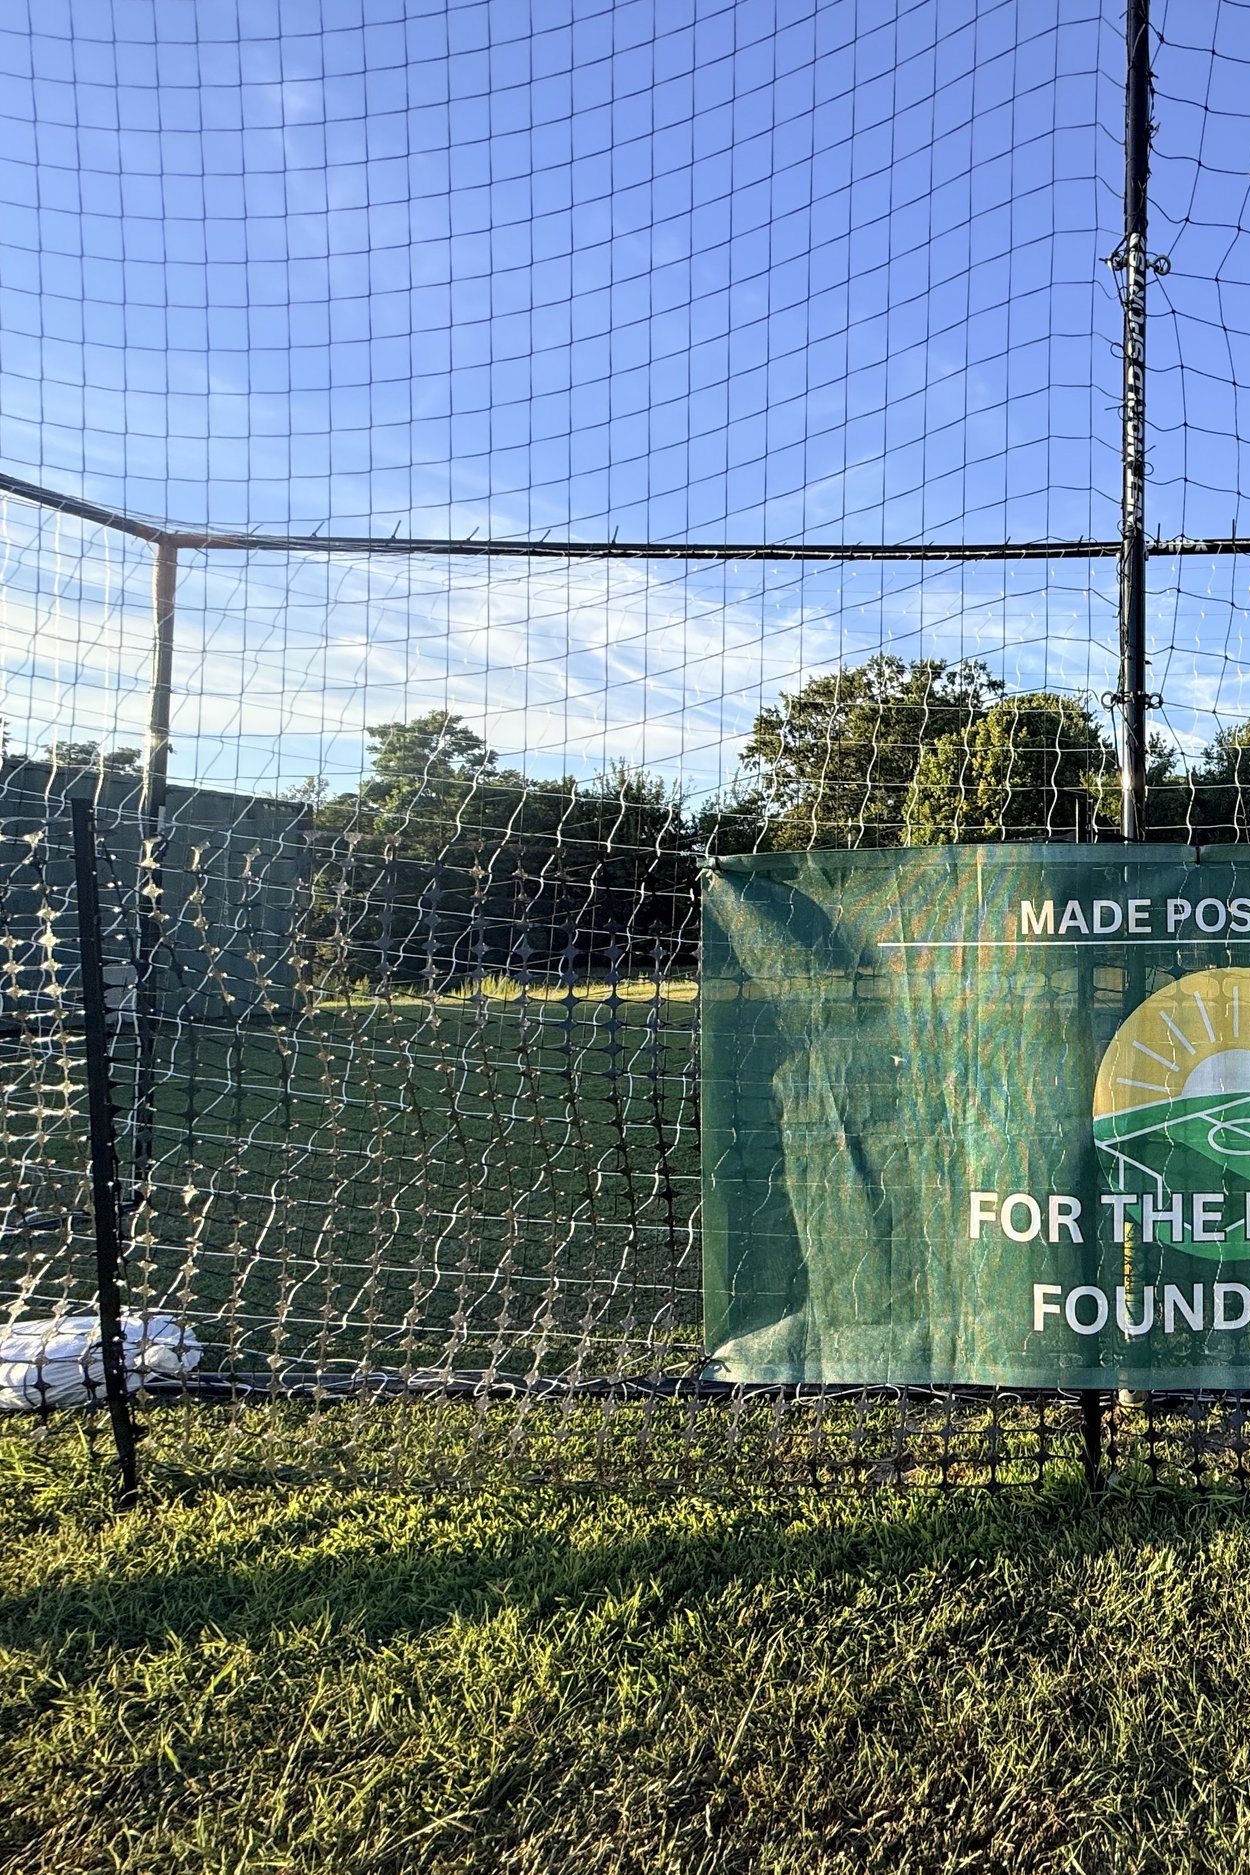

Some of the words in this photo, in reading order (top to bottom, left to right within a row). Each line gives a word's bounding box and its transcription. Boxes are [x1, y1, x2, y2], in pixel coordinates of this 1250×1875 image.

[1020, 899, 1151, 936] MADE
[970, 1191, 1083, 1243] FOR
[1101, 1190, 1226, 1243] THE
